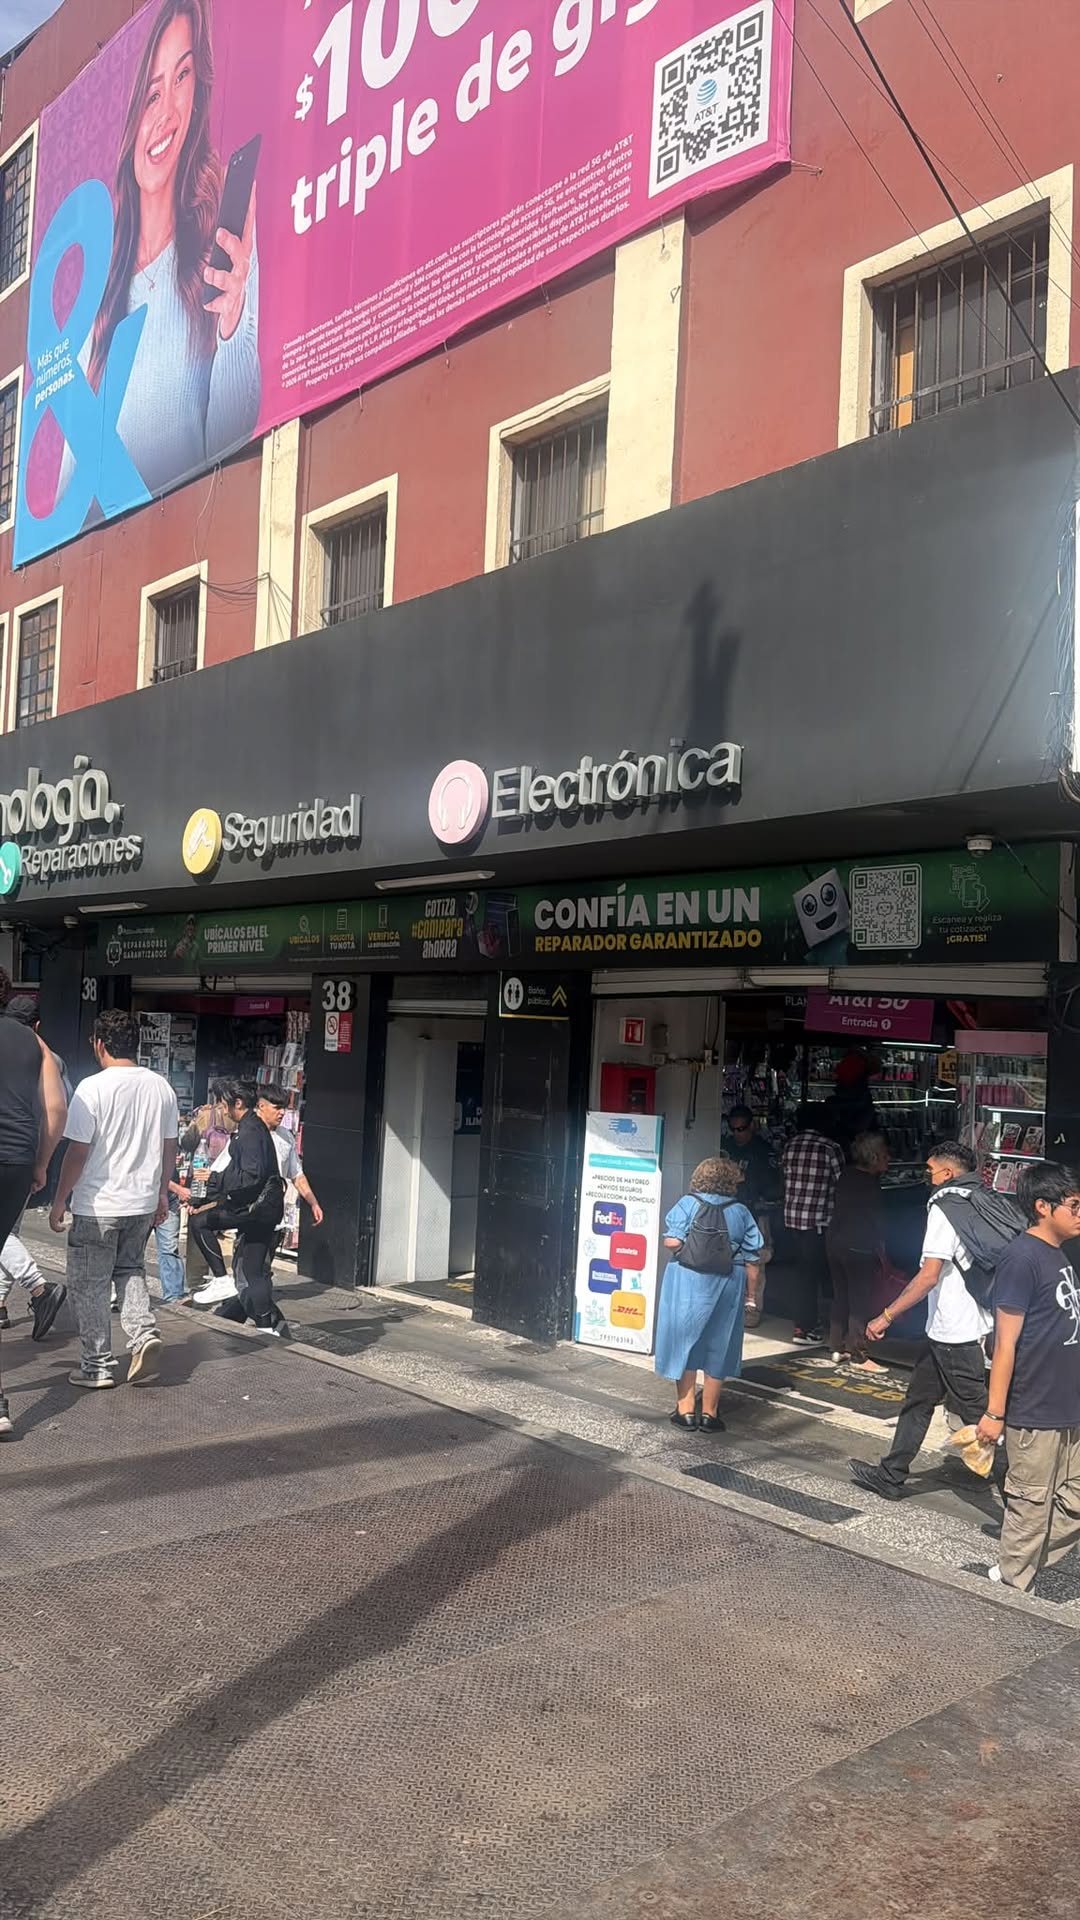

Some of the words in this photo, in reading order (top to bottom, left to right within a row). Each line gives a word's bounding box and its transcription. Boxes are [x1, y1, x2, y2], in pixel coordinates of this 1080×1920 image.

[693, 102, 720, 124] AT&T
[291, 97, 438, 234] triple
[456, 30, 532, 122] de
[37, 348, 53, 371] Más
[53, 338, 70, 361] que
[35, 369, 75, 410] personas.
[491, 736, 744, 819] Electrónica
[221, 793, 363, 857] Seguridad
[20, 835, 142, 881] Reparaciones
[534, 882, 650, 931] CONFÍA
[656, 890, 701, 926] EN
[707, 886, 761, 924] UN
[932, 914, 967, 924] Escanea
[974, 913, 1002, 923] realiza
[204, 925, 245, 941] UBÍCALOS
[246, 926, 259, 939] EN
[260, 925, 269, 938] EL
[368, 931, 400, 941] VERIFICA
[939, 926, 949, 934] tu
[950, 924, 992, 934] cotización
[207, 940, 238, 953] PRIMER
[239, 939, 265, 952] NIVEL
[330, 942, 337, 950] TU
[338, 941, 356, 950] NOTA
[535, 932, 627, 952] REPARADOR
[629, 928, 762, 951] GARANTIZADO
[946, 933, 987, 945] ¡GRATIS!
[82, 977, 97, 1001] 38
[322, 980, 351, 1011] 38
[841, 1016, 878, 1029] Entrada
[619, 1185, 643, 1194] SEGUROS
[624, 1177, 650, 1186] MAYOREO
[629, 1195, 656, 1204] DOMICILIO
[595, 1210, 623, 1226] FedEx
